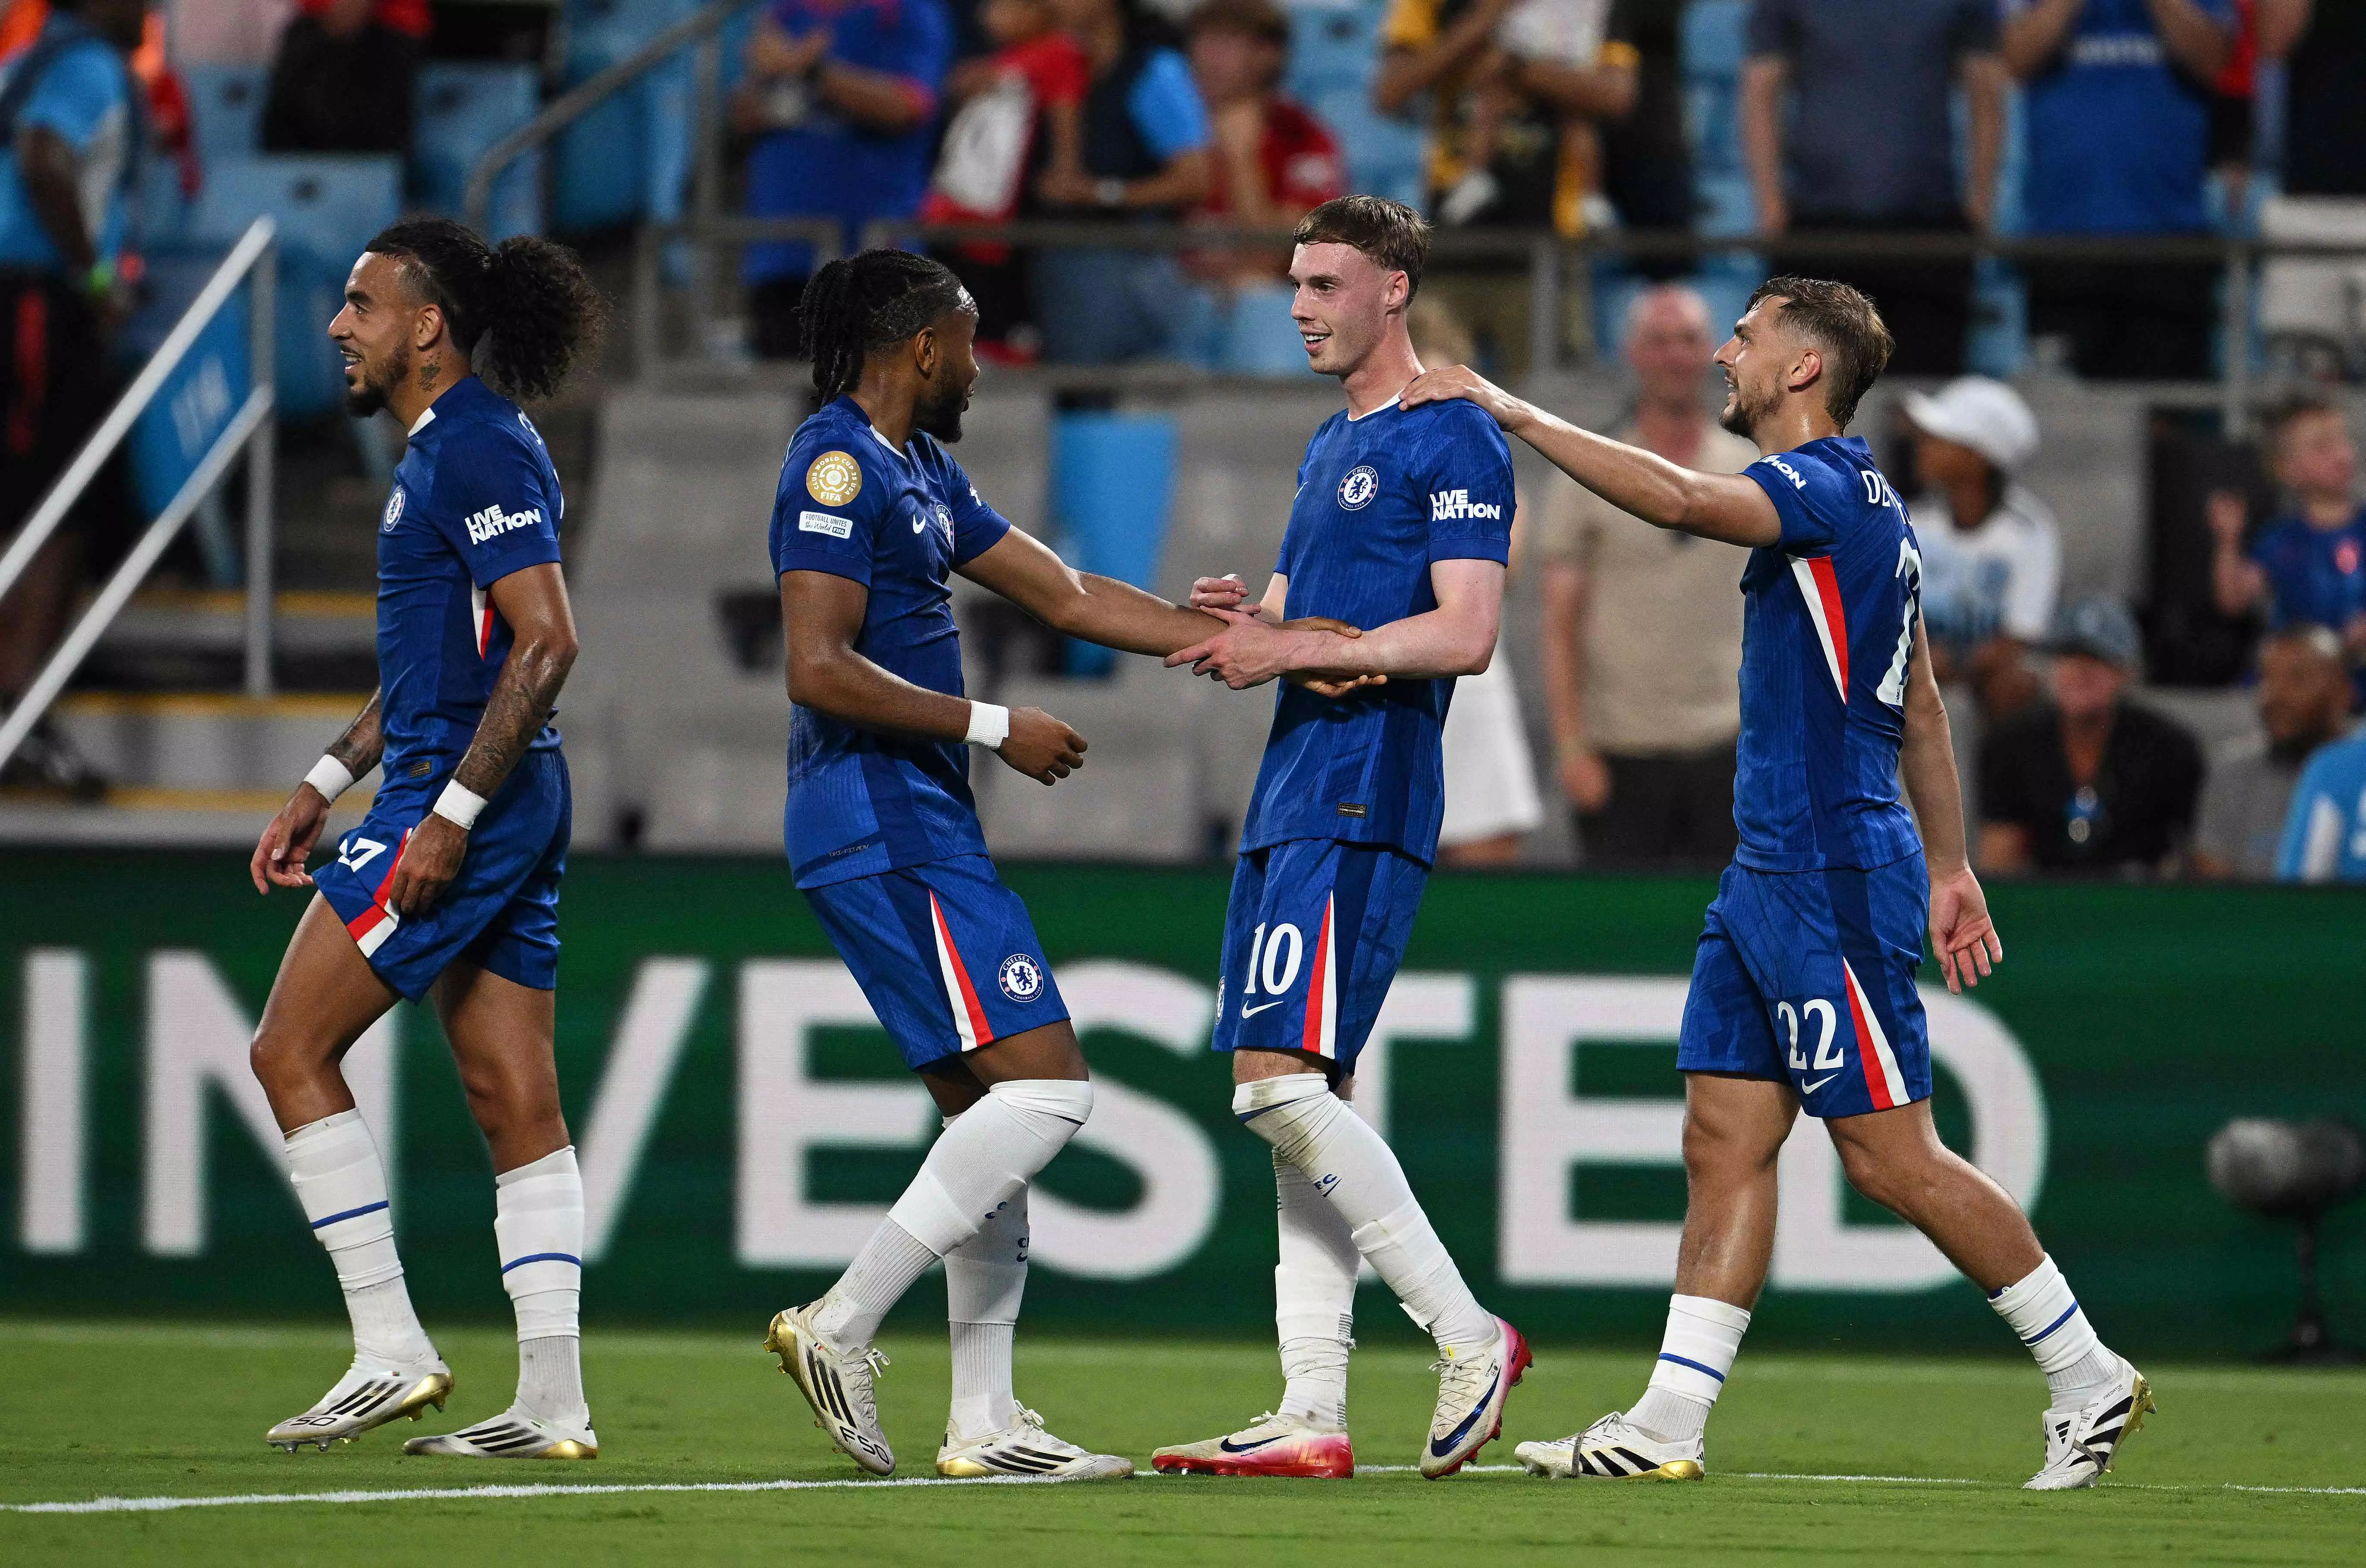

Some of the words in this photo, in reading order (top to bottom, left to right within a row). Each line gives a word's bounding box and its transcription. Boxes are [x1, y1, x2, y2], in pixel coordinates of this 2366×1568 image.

[815, 456, 839, 470] WORLD
[842, 459, 854, 469] CUP
[851, 472, 857, 480] 25
[1353, 468, 1375, 479] CHELSEA
[845, 482, 856, 495] USA
[820, 491, 841, 502] FIFA
[1429, 489, 1468, 507] LIVE
[464, 504, 503, 532] LIVE
[1432, 503, 1501, 521] NATION
[469, 508, 541, 545] NATION
[806, 514, 828, 523] FOOTBALL
[831, 518, 847, 527] UNITES
[814, 522, 831, 532] World
[1003, 956, 1029, 970] CHELSEA
[1244, 922, 1303, 996] 10
[1778, 999, 1844, 1070] 22
[2103, 1384, 2122, 1401] PREDATOR
[839, 1426, 890, 1465] F50
